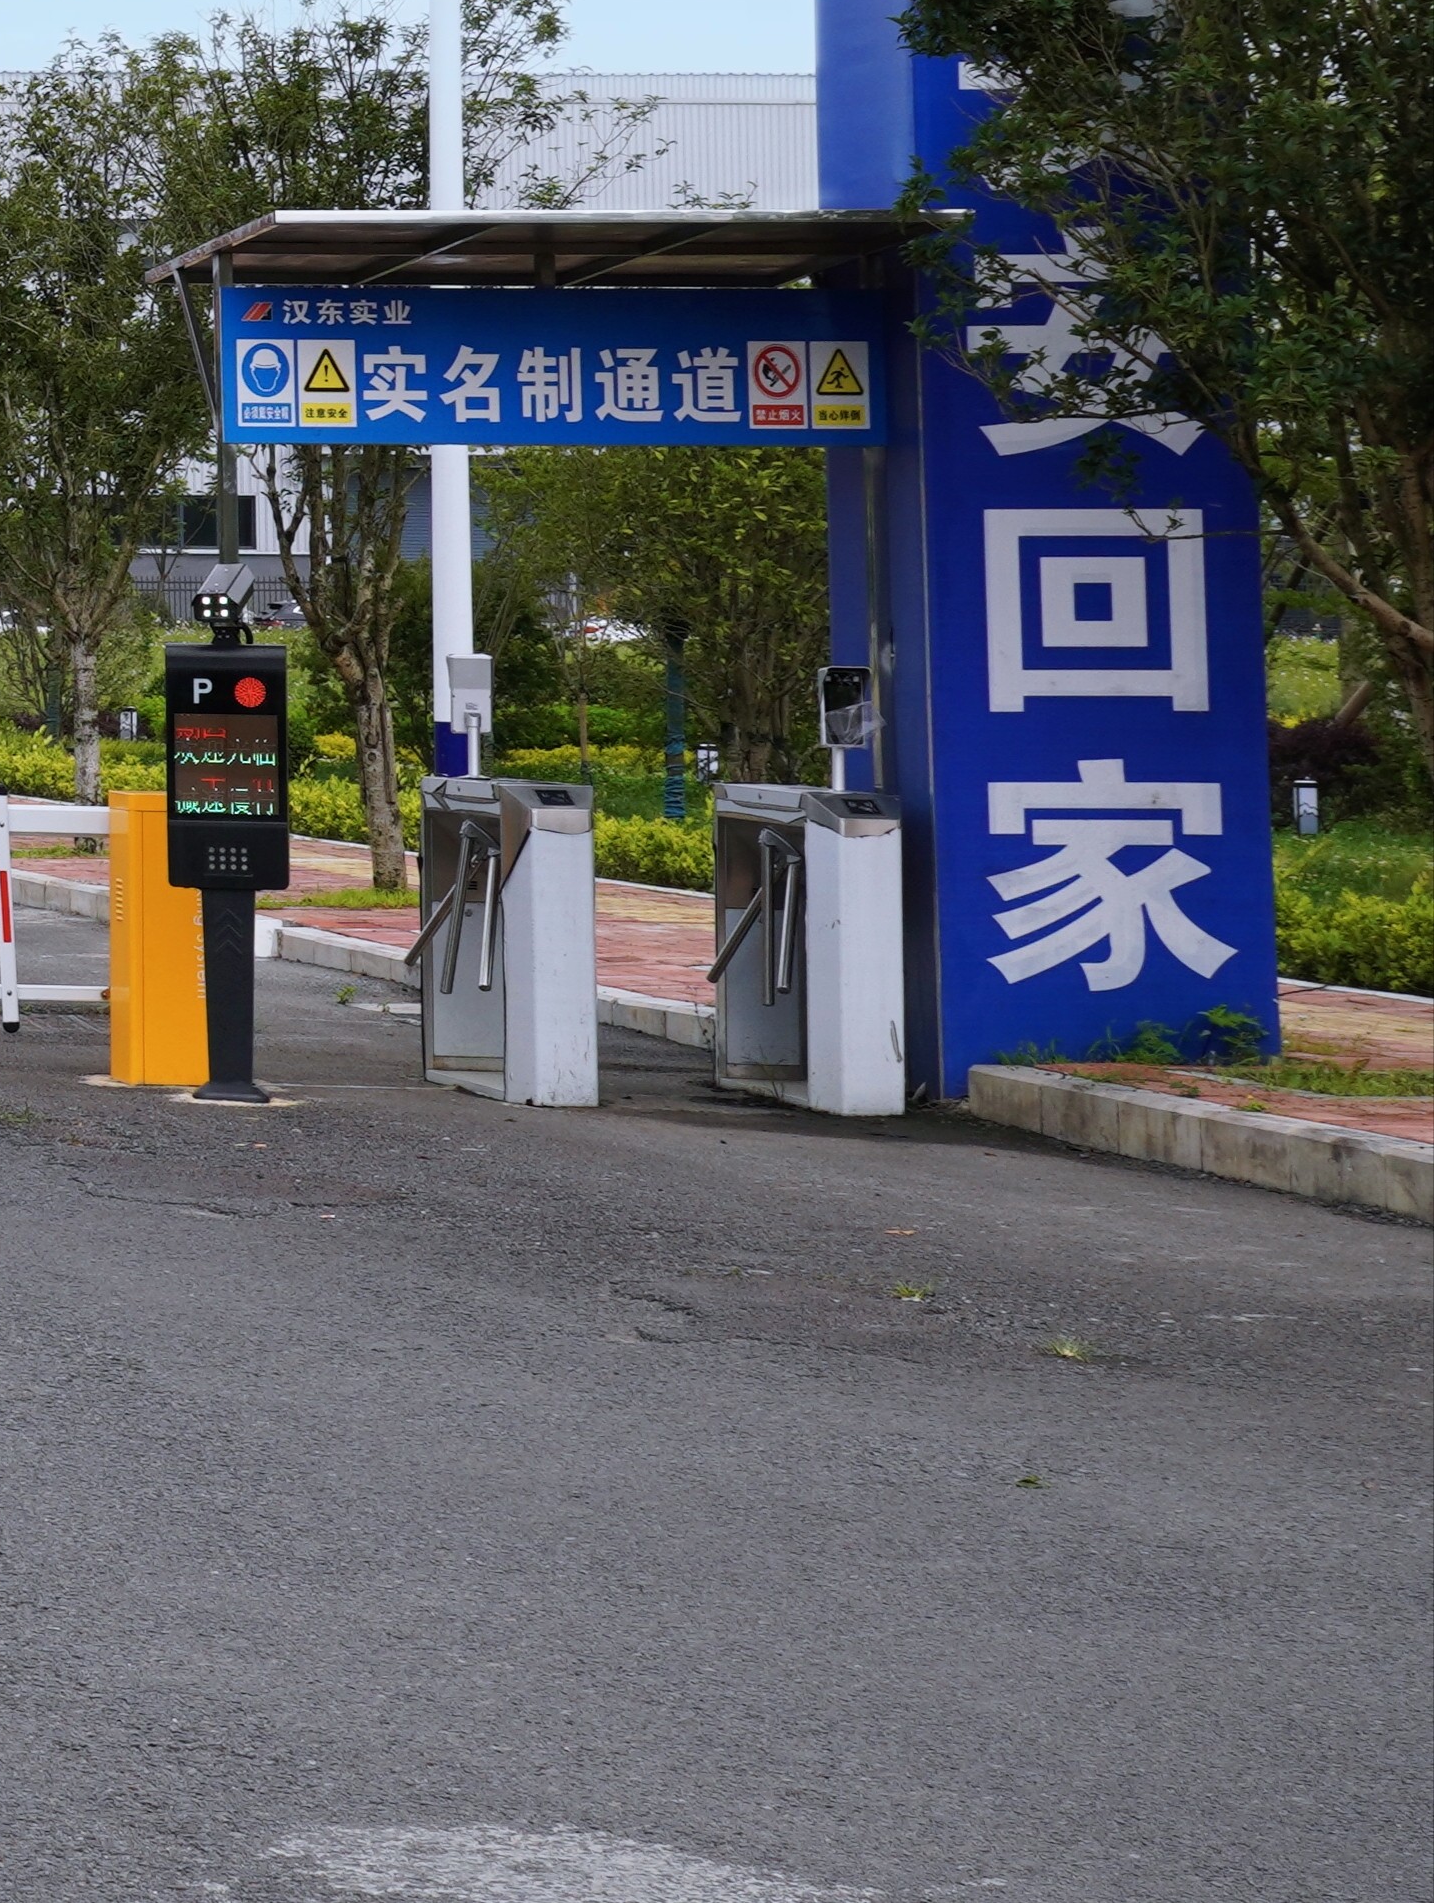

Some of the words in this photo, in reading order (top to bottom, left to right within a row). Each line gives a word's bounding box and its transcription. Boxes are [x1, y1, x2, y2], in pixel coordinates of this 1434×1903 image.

[281, 299, 413, 326] 汉东实业
[363, 345, 742, 424] 实名制通道
[305, 408, 348, 419] 注意安全
[755, 409, 802, 422] 禁止烟火
[818, 409, 861, 421] 当心绊倒
[193, 677, 213, 704] P
